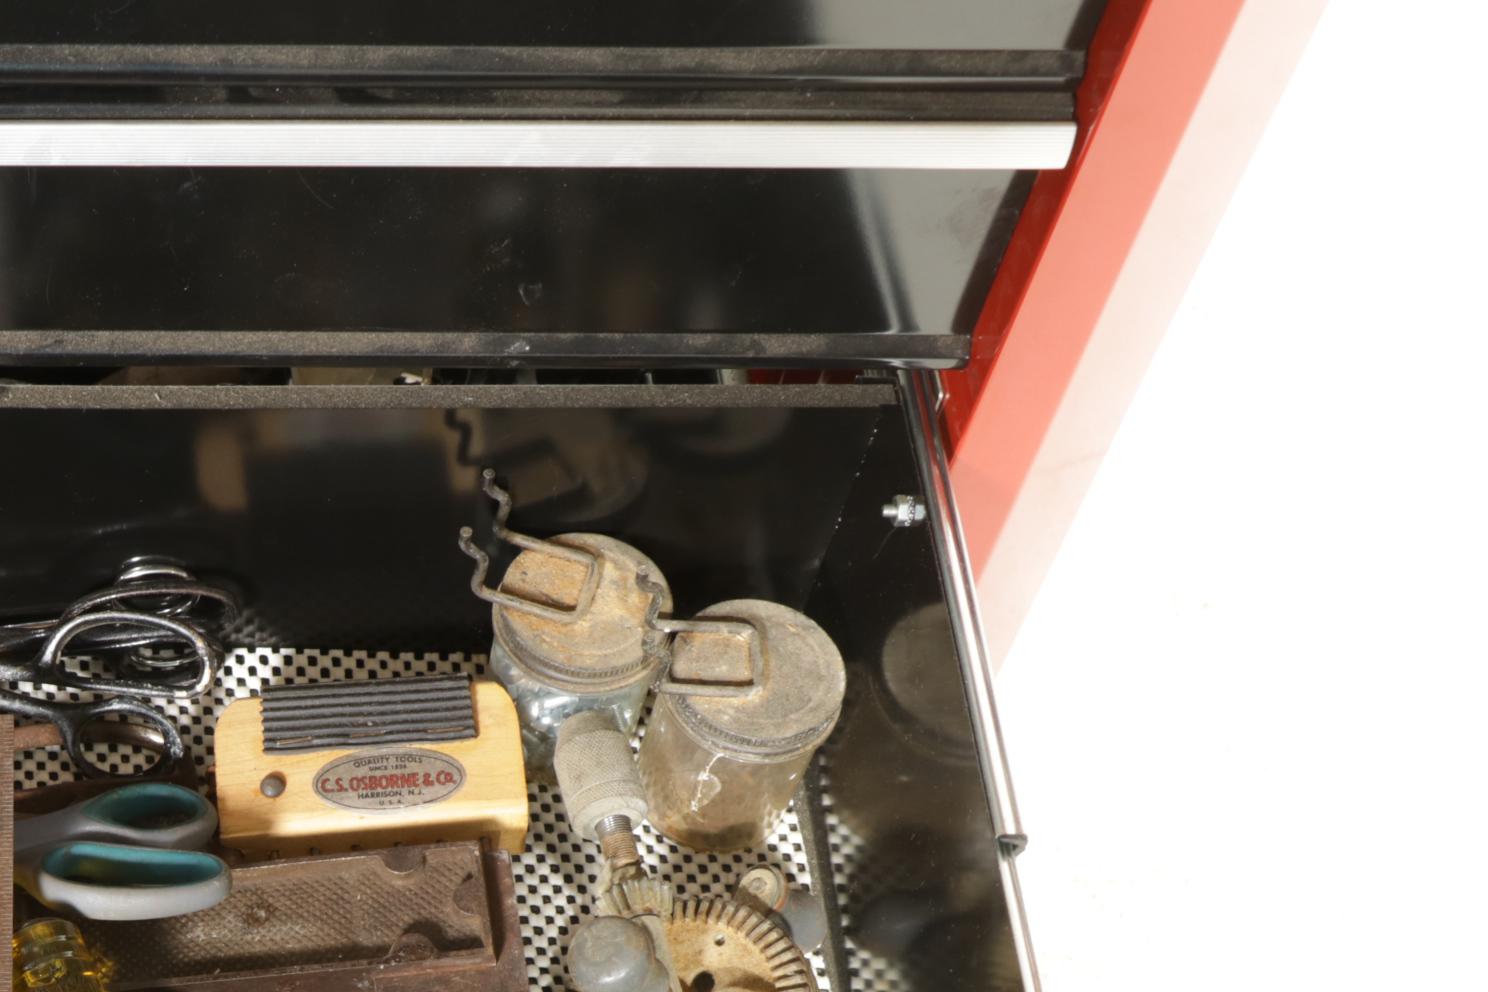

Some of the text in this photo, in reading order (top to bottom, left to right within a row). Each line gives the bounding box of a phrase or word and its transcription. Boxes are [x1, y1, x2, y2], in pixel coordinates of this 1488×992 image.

[353, 754, 423, 768] QUALITY TOOLS
[320, 777, 348, 793] C.S.
[349, 772, 419, 792] OSBORNE
[422, 771, 435, 787] &
